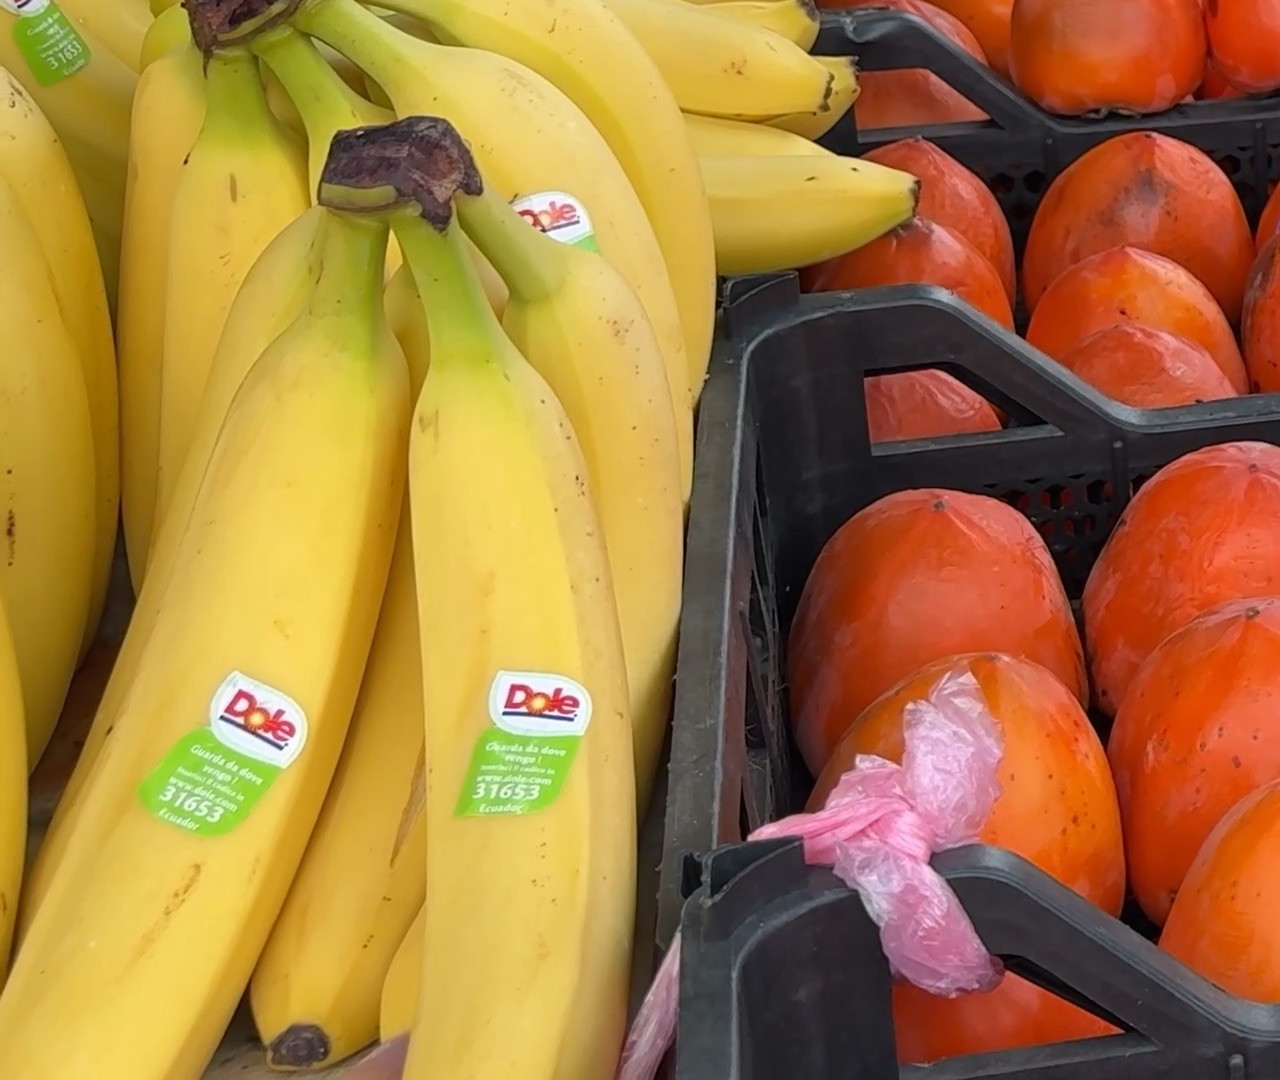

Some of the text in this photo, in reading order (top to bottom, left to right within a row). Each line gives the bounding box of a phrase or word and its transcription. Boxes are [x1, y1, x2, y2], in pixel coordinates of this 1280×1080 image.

[503, 683, 581, 715] Dole
[223, 688, 297, 742] Dole
[485, 741, 567, 757] Guarda da dove
[505, 754, 536, 764] vengo
[190, 744, 264, 786] Guarda da dove
[202, 764, 232, 783] vengo
[476, 774, 552, 786] www.dole.com
[168, 776, 238, 813] www.dole.com
[472, 782, 541, 801] 31653
[158, 785, 224, 823] 31653
[479, 802, 523, 815] Ecuador
[158, 807, 200, 831] Ecuador
